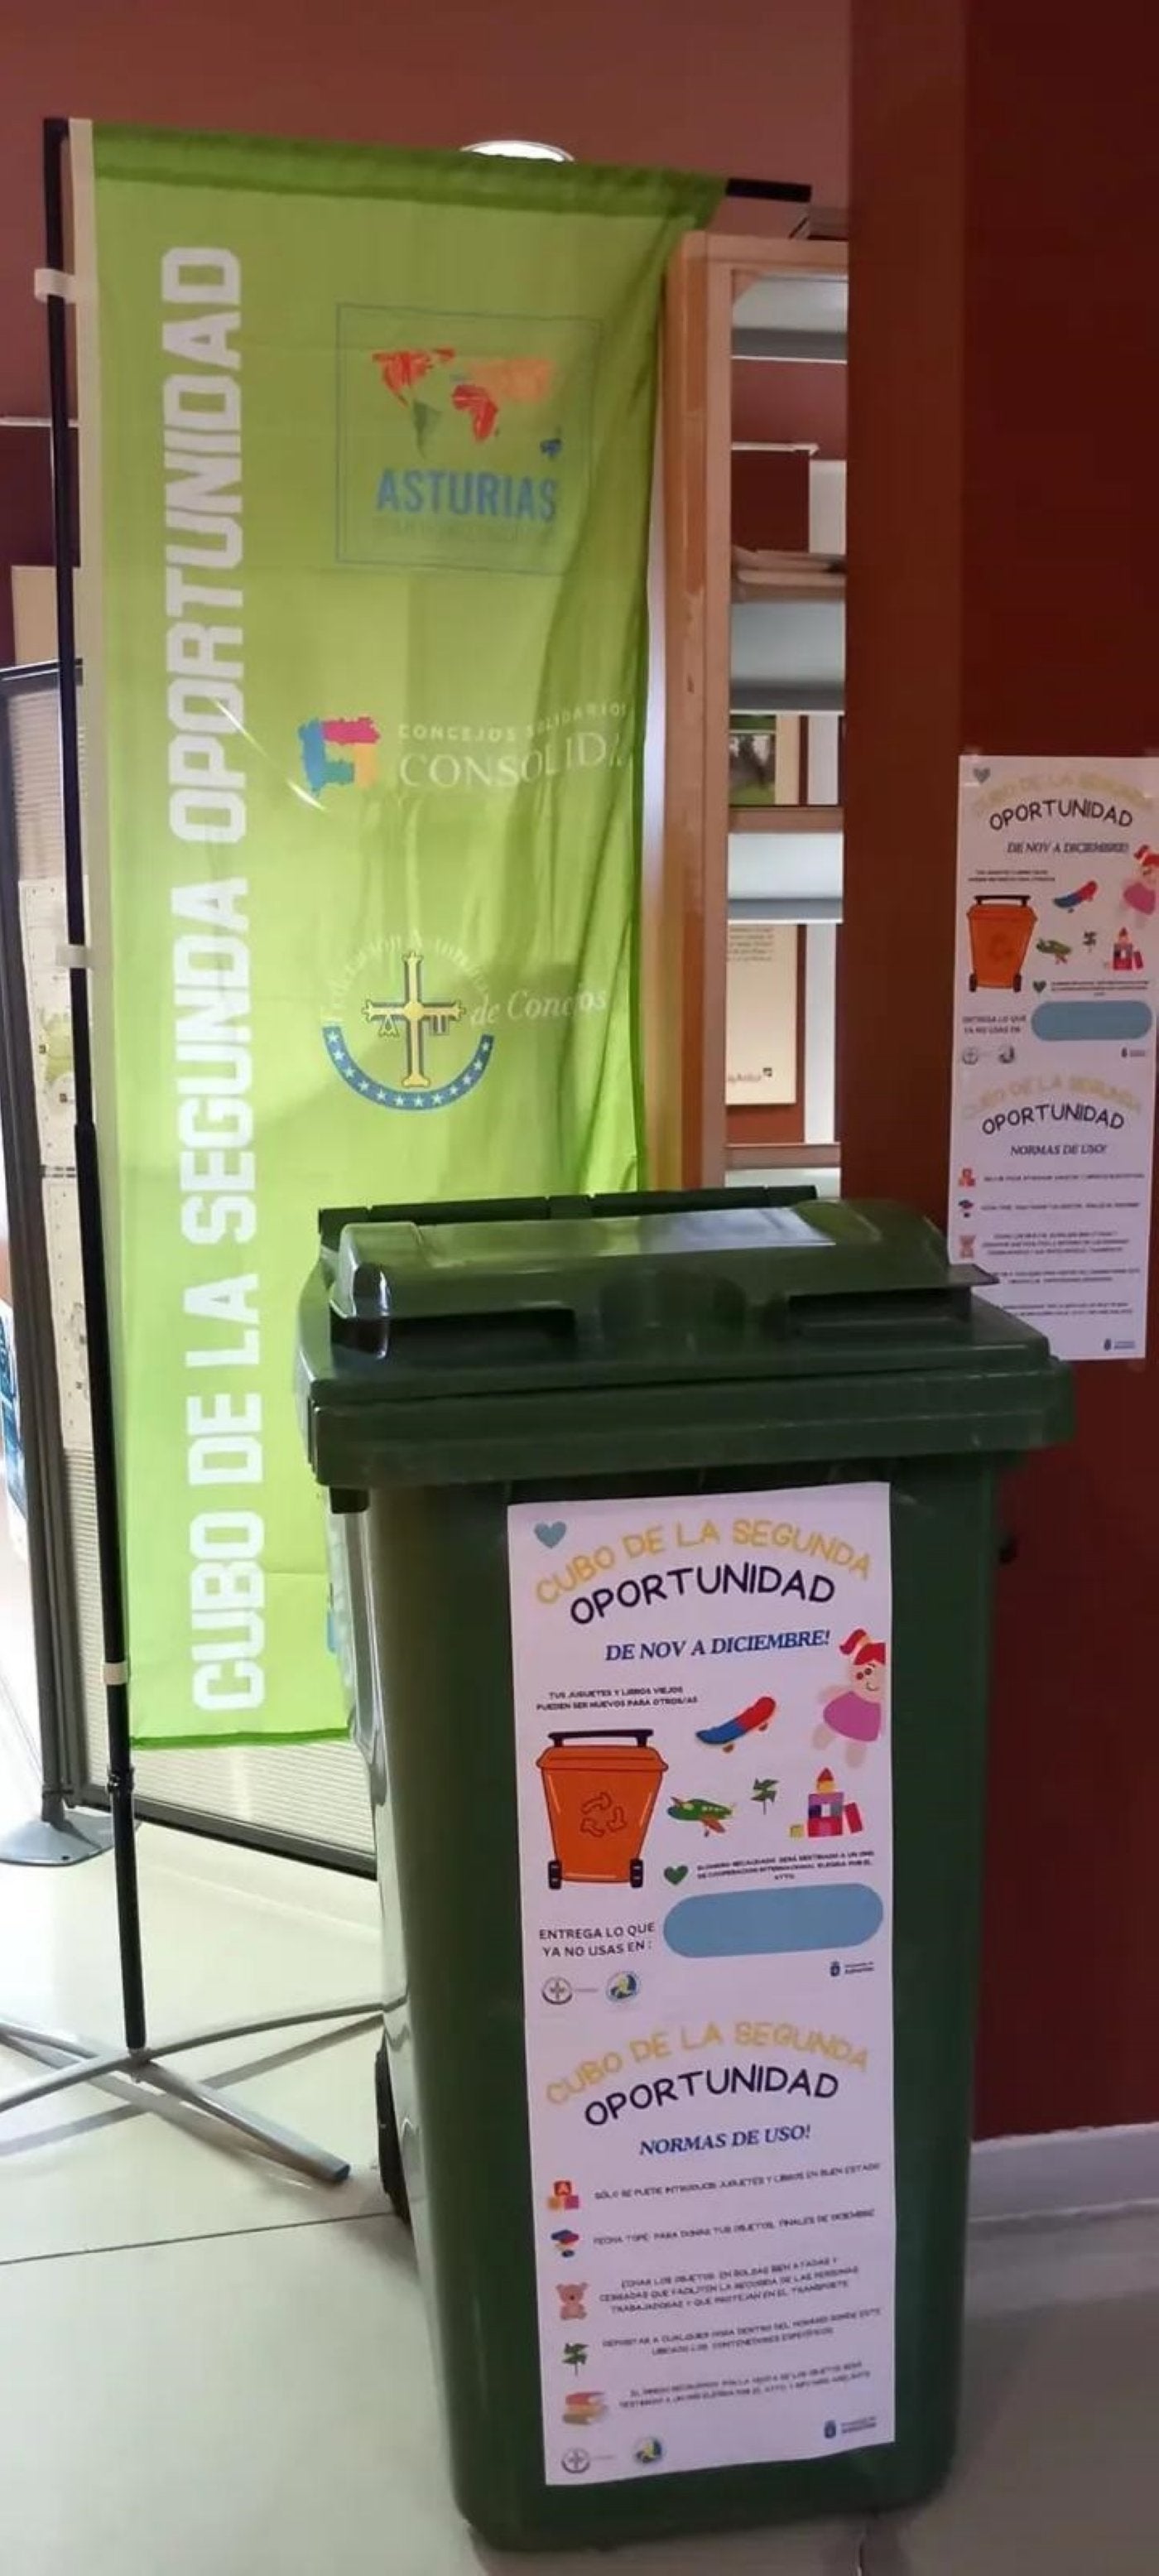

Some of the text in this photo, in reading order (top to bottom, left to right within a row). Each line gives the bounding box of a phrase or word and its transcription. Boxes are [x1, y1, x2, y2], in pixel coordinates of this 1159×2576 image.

[377, 467, 560, 523] ASTURIAS
[398, 723, 517, 744] CONCEJOS
[988, 797, 1133, 831] OPORTUNIDAD
[1008, 841, 1024, 853] DE
[1053, 841, 1061, 853] A
[162, 248, 267, 1712] CUBO DE LA SEGUNDA OPORTUNIDAD
[507, 988, 607, 1020] Concos
[982, 1102, 1125, 1135] OPORTUNIDAD
[1010, 1144, 1060, 1156] NORMAS
[1062, 1144, 1078, 1155] DE
[536, 1518, 872, 1605] CUBO DE LA SEGUNDA
[570, 1561, 836, 1625] OPORTUNIDAD
[605, 1629, 830, 1661] DE NOV A DICIEMBRE!
[539, 1922, 656, 1940] ENTREGA LO QUE
[542, 1946, 561, 1957] YA
[565, 1946, 585, 1957] NO
[588, 1943, 624, 1957] USAS
[628, 1940, 645, 1953] EN
[546, 2020, 869, 2107] CUBO DE LA SEGUNDA
[584, 2063, 839, 2126] OPORTUNIDAD
[637, 2123, 811, 2156] NORMAS DE USO!
